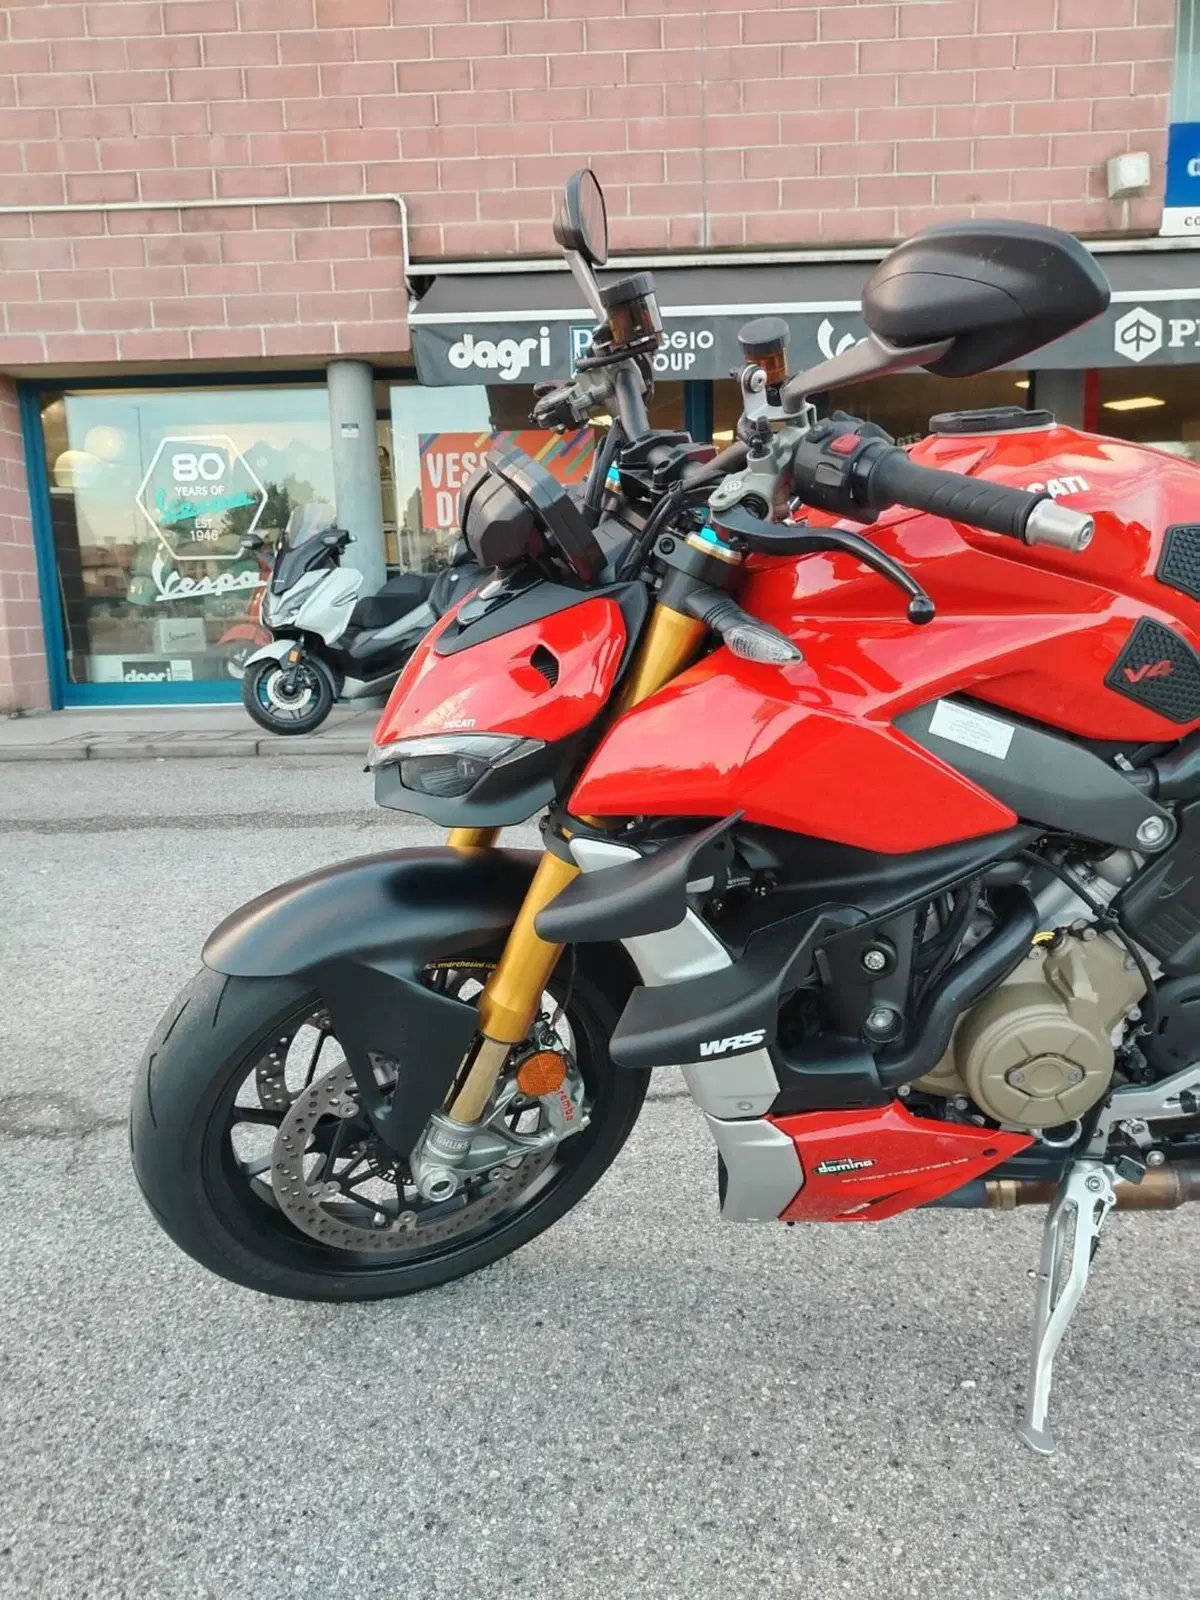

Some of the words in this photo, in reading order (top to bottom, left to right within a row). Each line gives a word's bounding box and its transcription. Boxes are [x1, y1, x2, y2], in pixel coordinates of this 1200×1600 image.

[658, 330, 714, 350] GGIO
[1167, 318, 1200, 348] P
[448, 326, 551, 381] dagri
[653, 352, 696, 372] OUP
[171, 453, 226, 482] 80
[426, 452, 488, 489] VES
[175, 486, 208, 496] YEARS
[211, 485, 225, 495] OF
[1029, 476, 1090, 499] CATI
[436, 491, 461, 527] D
[195, 519, 213, 529] EST
[190, 531, 219, 542] 1946
[152, 553, 268, 602] Vespa
[1123, 660, 1173, 683] V4
[700, 1028, 767, 1057] WRS
[818, 1158, 873, 1173] domino
